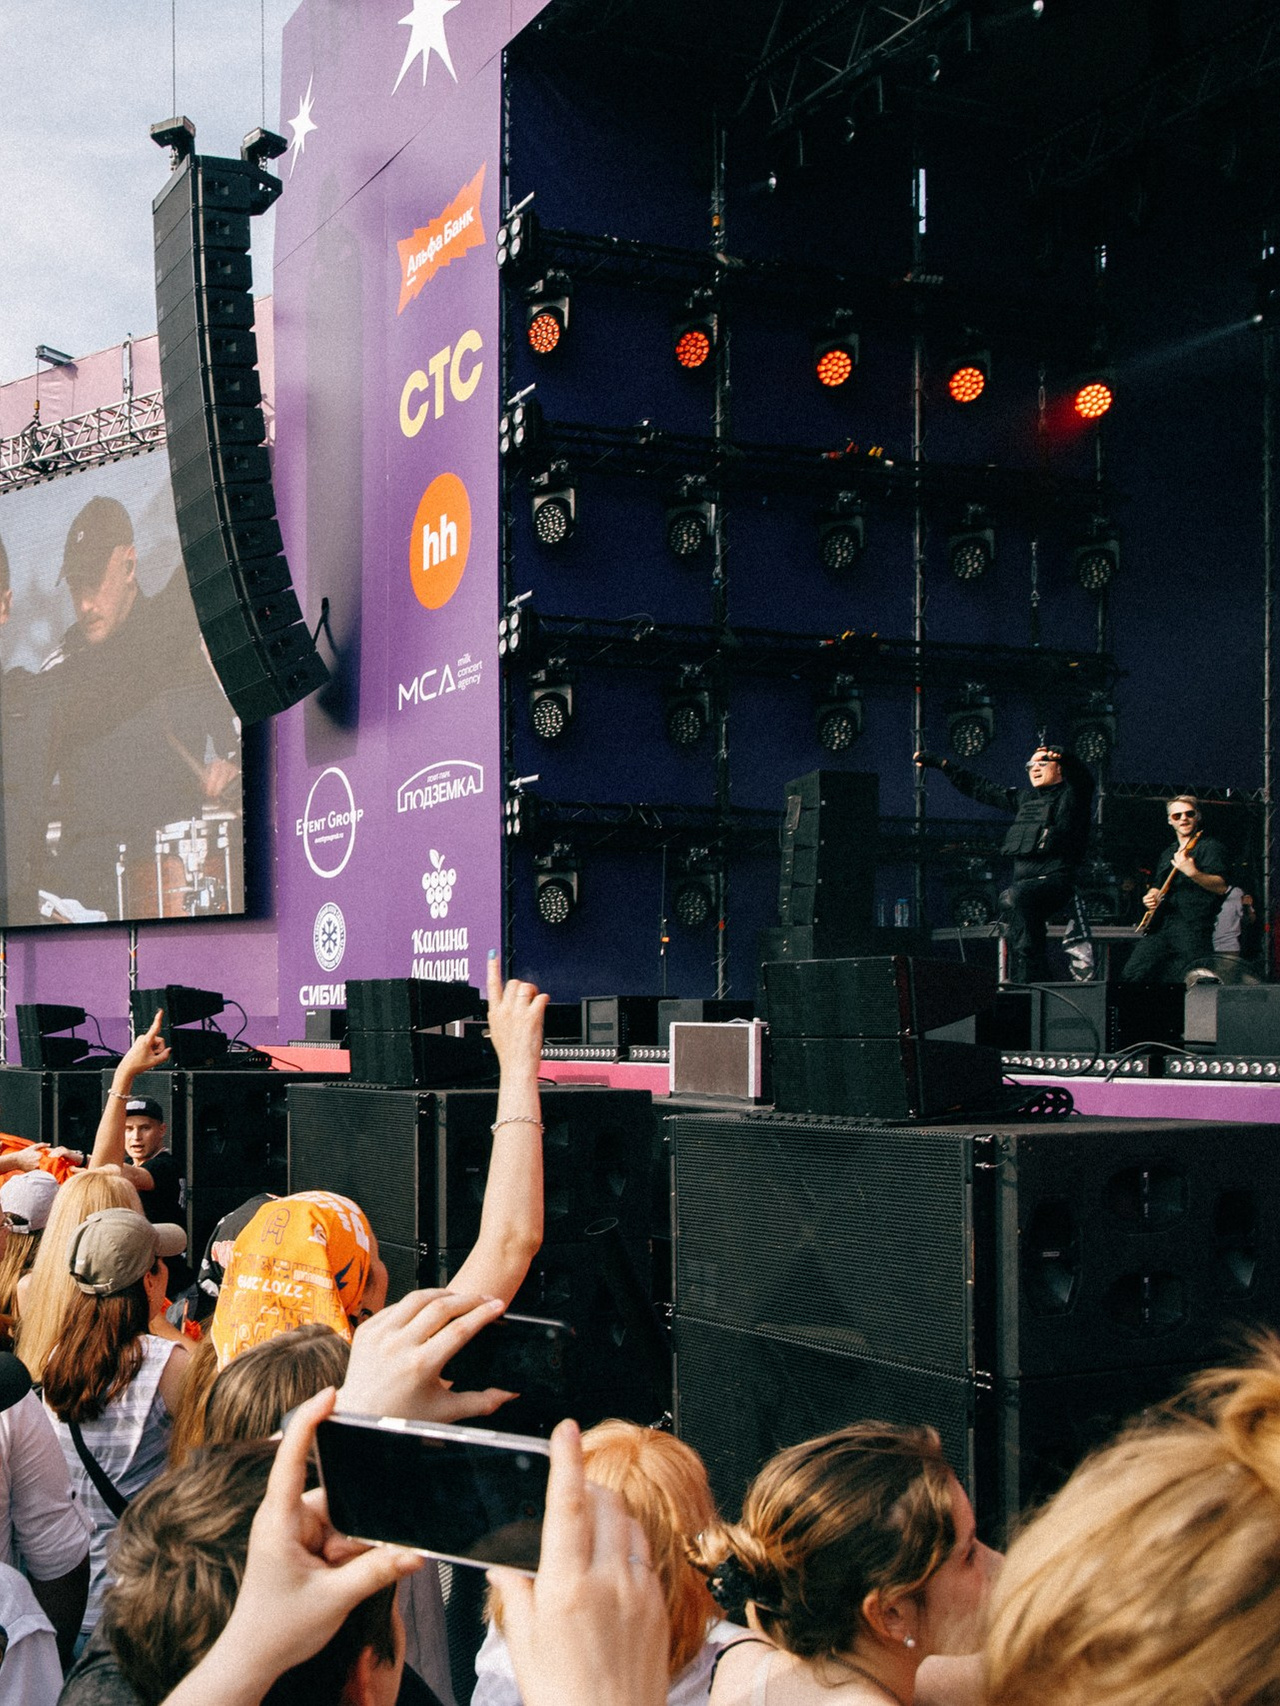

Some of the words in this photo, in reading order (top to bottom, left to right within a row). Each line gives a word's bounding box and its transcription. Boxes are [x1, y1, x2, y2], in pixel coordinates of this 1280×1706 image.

[406, 234, 443, 277] Альфа
[444, 206, 474, 245] Банк
[399, 330, 483, 437] СТС
[422, 513, 457, 571] hh
[457, 673, 481, 690] agency
[458, 660, 483, 677] concert
[398, 664, 456, 711] MCA
[404, 775, 476, 810] ПОДЗЕМКА
[411, 926, 469, 955] Калина
[411, 957, 470, 983] Малина
